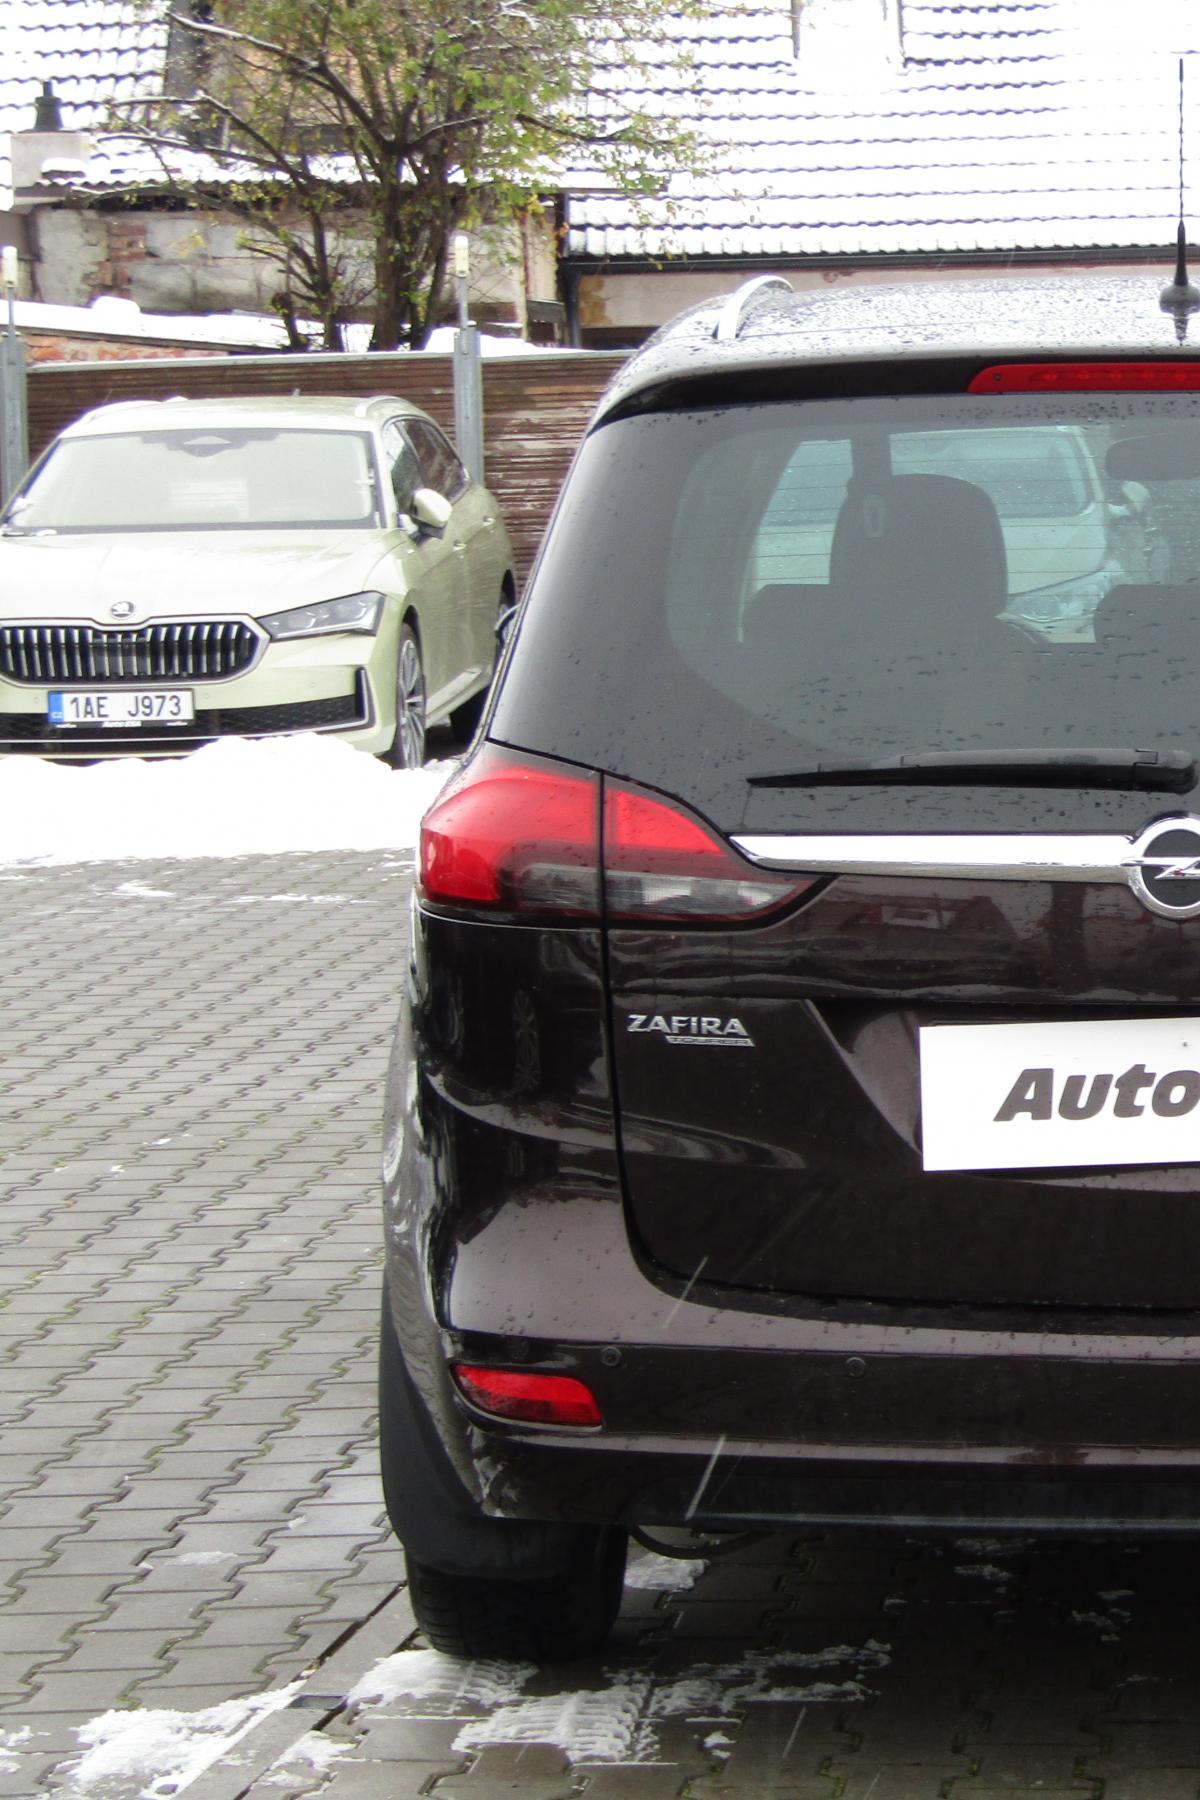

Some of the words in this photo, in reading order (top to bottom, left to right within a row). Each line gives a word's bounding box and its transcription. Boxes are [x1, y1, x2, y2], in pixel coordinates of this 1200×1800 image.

[70, 696, 109, 719] 1AE
[128, 695, 182, 717] J973
[627, 1014, 748, 1036] ZAFIRA
[671, 1036, 749, 1046] TOURER
